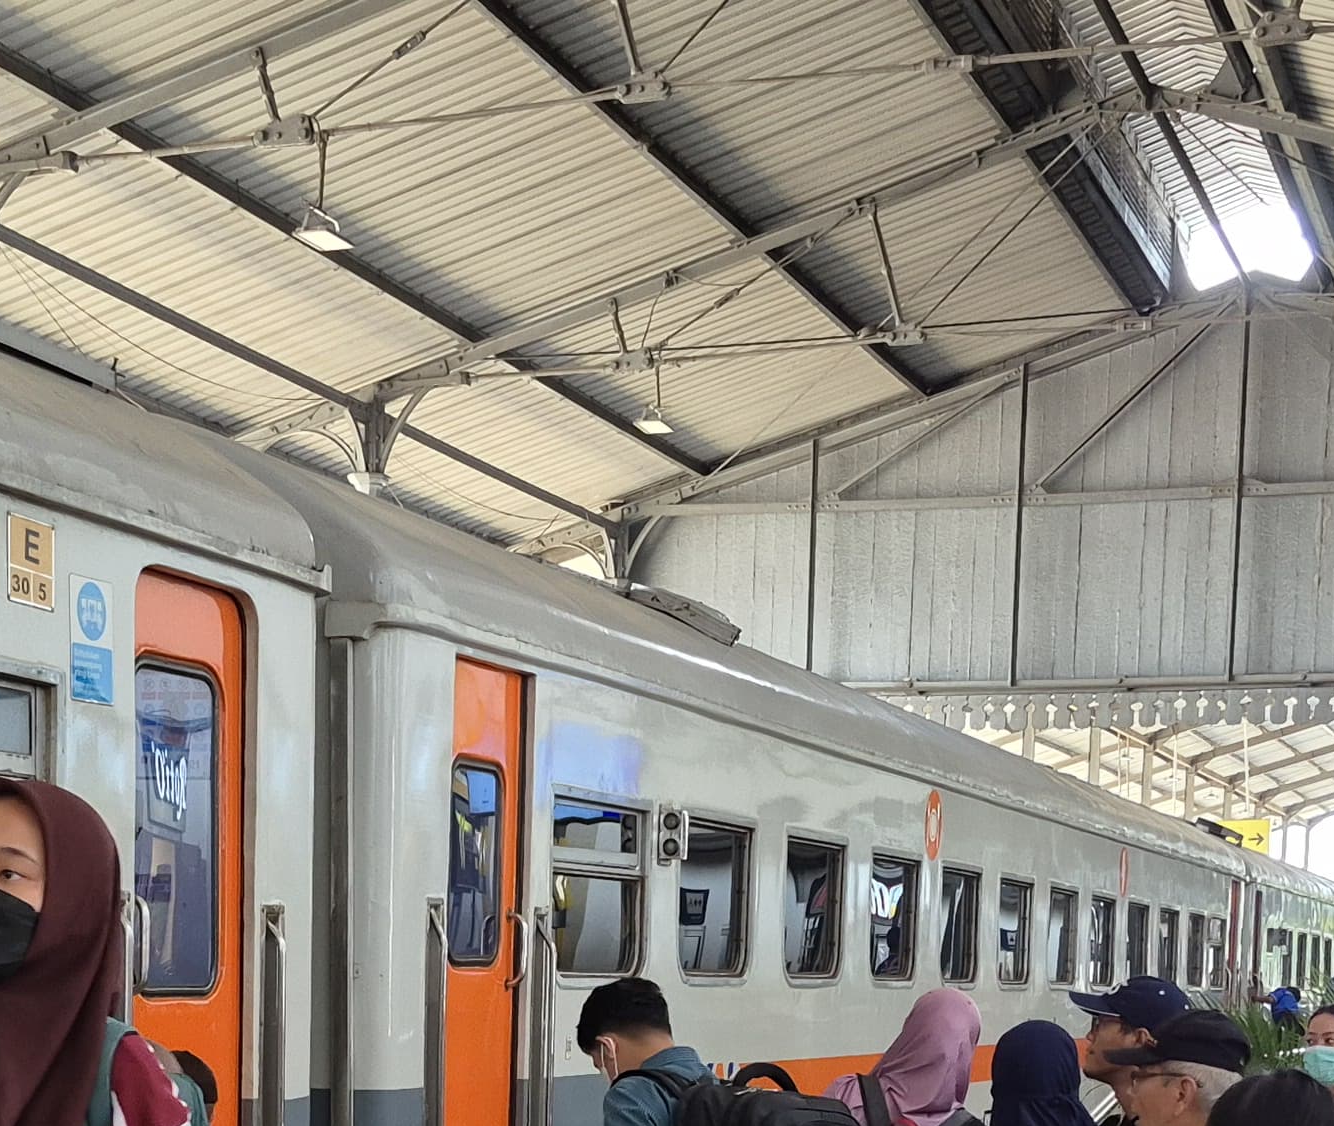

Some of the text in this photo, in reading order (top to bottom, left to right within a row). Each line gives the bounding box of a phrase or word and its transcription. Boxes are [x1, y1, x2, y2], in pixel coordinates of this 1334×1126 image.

[24, 528, 40, 565] E
[11, 574, 47, 601] 30 5
